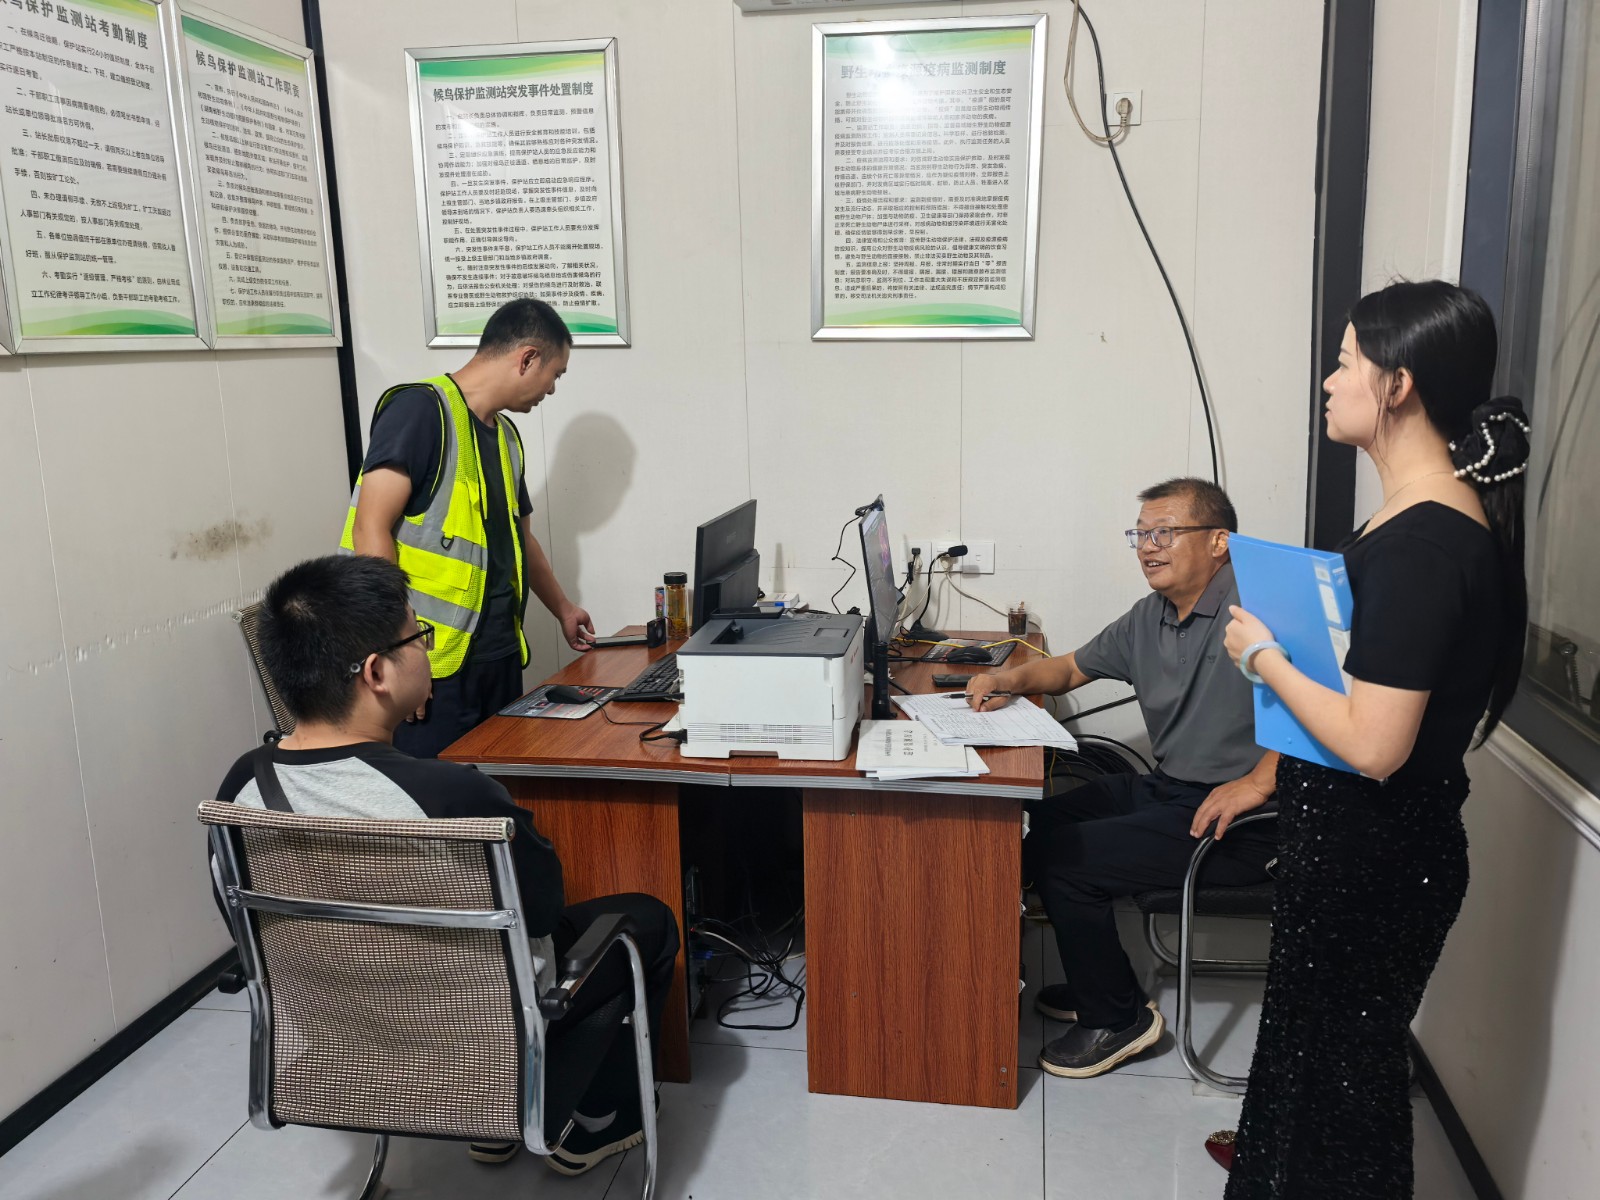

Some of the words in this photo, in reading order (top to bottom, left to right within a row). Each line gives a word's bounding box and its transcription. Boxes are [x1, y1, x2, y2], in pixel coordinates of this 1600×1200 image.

[0, 0, 149, 49] 鸟保护监测站考勤制度
[195, 49, 300, 98] 候鸟保护监测站工作职责
[841, 60, 1006, 79] 野生疫源疫病监测制度
[433, 81, 594, 102] 候鸟保护监测站突发事件处置制度
